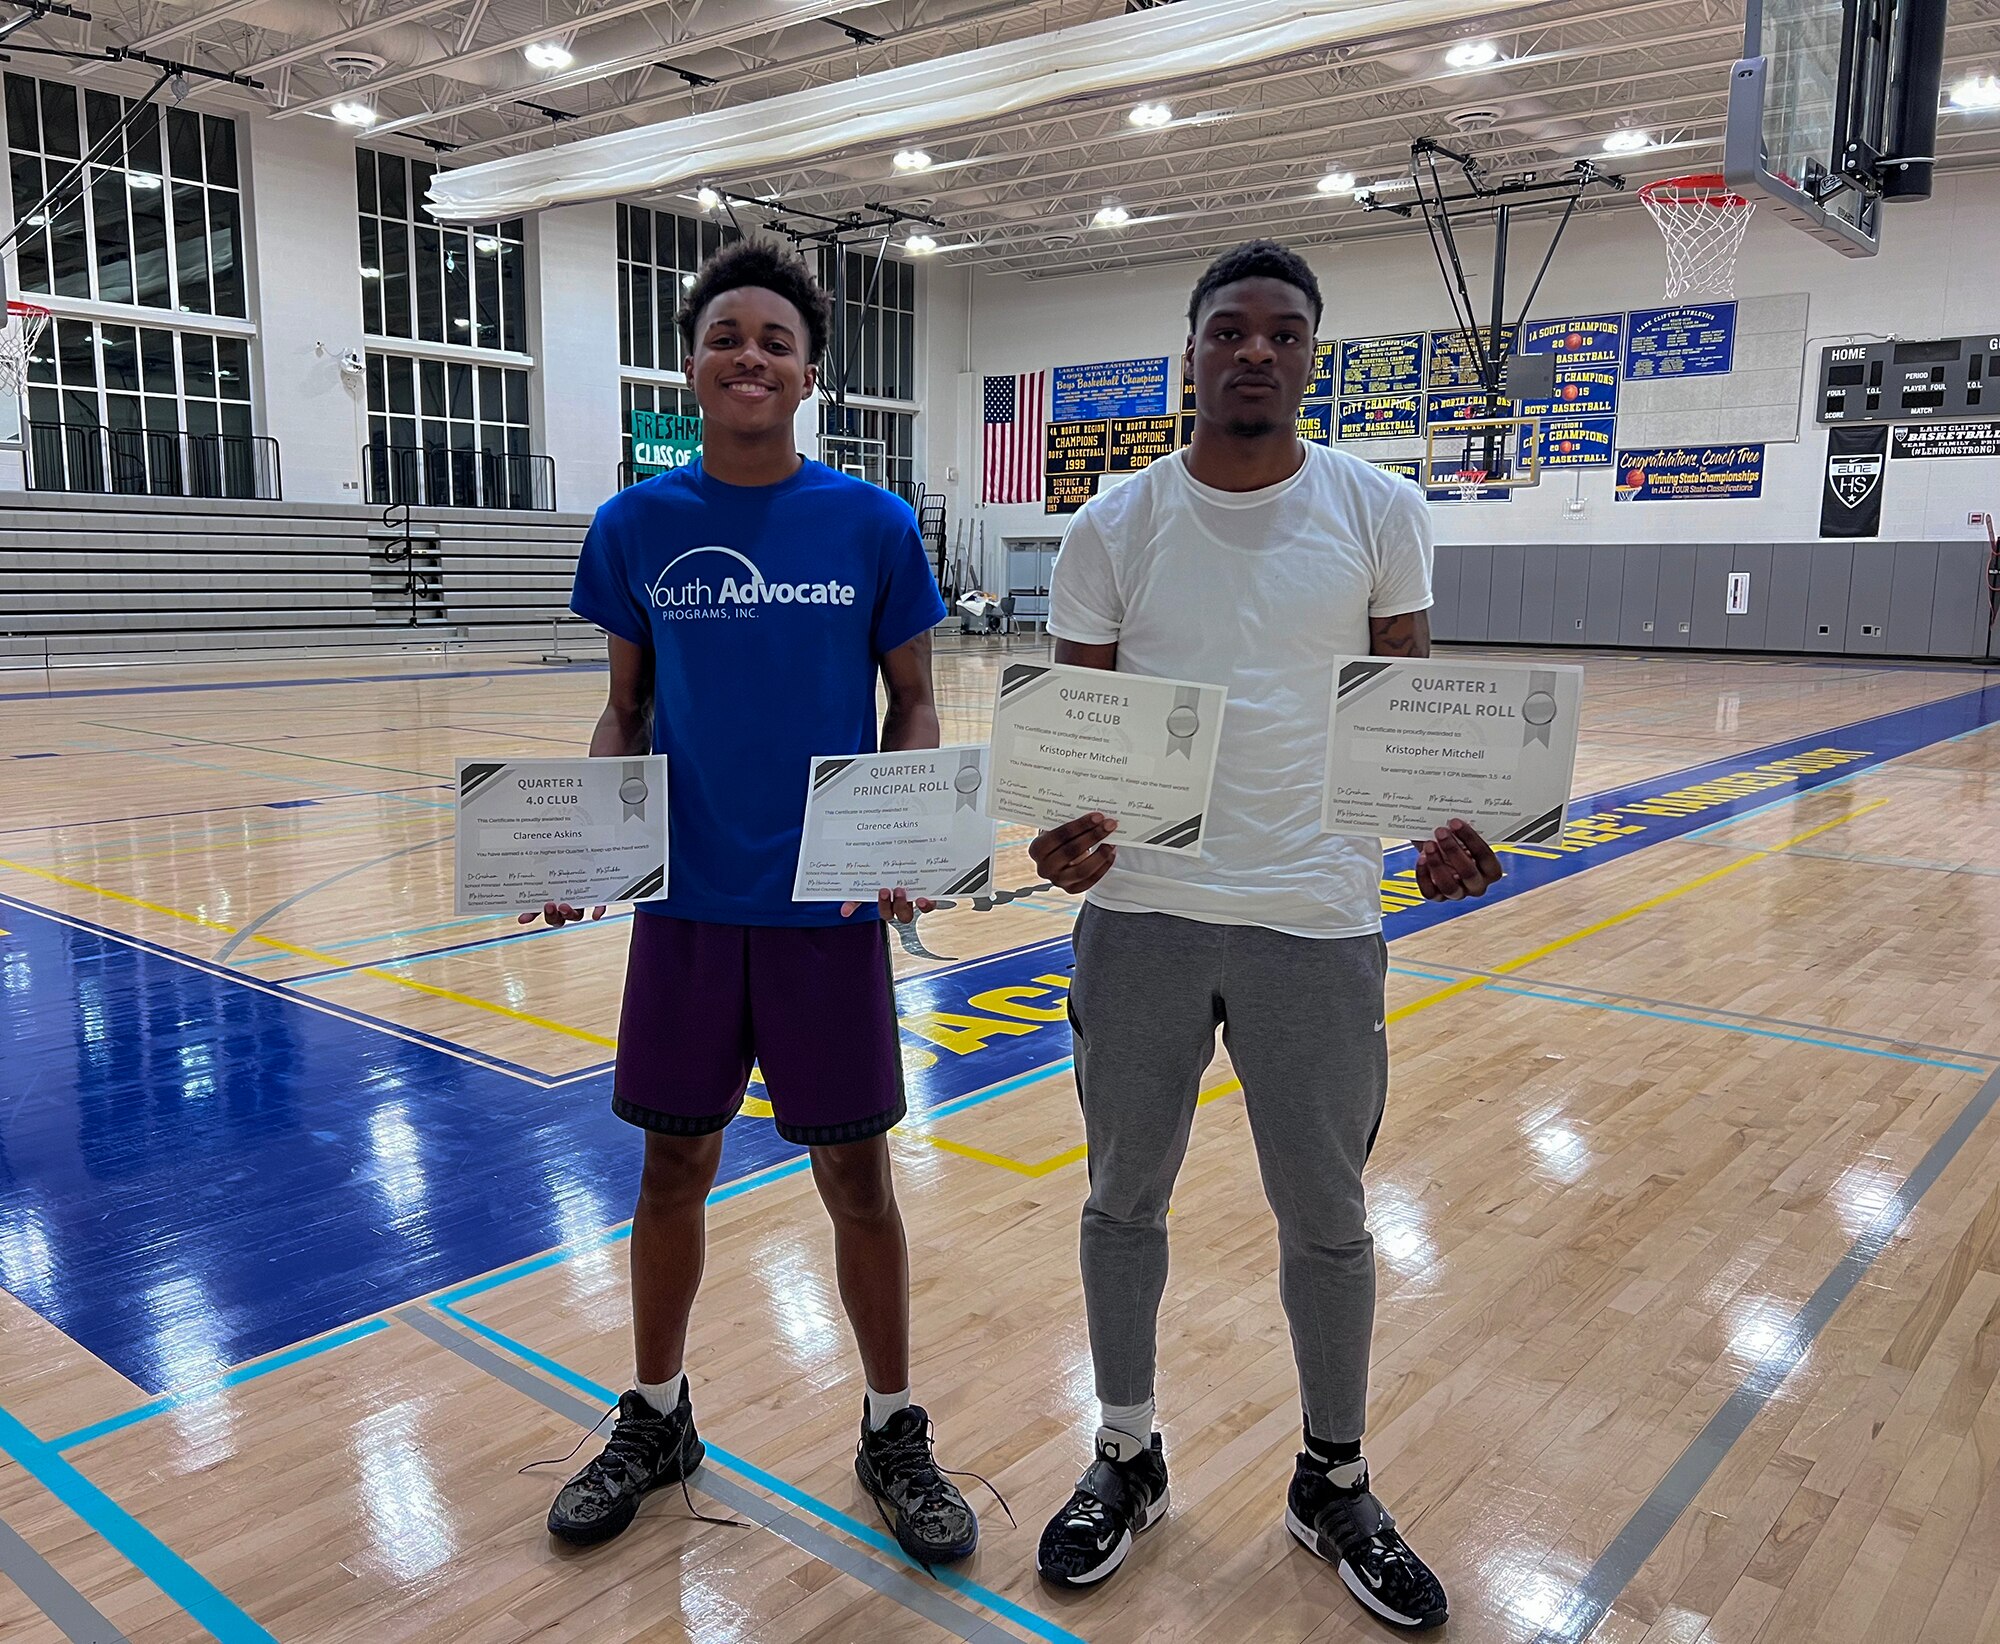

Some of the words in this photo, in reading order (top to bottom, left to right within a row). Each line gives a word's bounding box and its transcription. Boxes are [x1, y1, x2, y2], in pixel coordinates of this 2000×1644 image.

[1636, 321, 1652, 332] LAKE
[1654, 311, 1679, 322] CLIFTON
[1682, 310, 1715, 320] ATHLETICS
[1529, 331, 1537, 342] 1A
[1539, 323, 1566, 337] SOUTH
[1569, 322, 1618, 334] CHAMPIONS
[1552, 340, 1564, 348] 20
[1583, 337, 1592, 346] 16
[1556, 351, 1615, 363] BASKETBALL
[1832, 348, 1866, 361] HOME
[1056, 381, 1075, 390] Boys
[1077, 375, 1119, 388] Basketball
[1122, 374, 1164, 385] Champions
[1565, 373, 1614, 386] CHAMPIONS
[1905, 372, 1928, 380] PERIOD
[1579, 387, 1589, 396] 15
[1343, 401, 1362, 416] CITY
[1365, 398, 1416, 411] CHAMPIONS
[1441, 397, 1465, 408] NORTH
[1525, 405, 1549, 415] BOYS'
[1552, 401, 1611, 413] BASKETBALL
[635, 411, 703, 441] FRESHM
[1050, 427, 1057, 436] 4A
[1061, 425, 1082, 435] NORTH
[1084, 424, 1105, 433] REGION
[1115, 422, 1122, 431] 4A
[1126, 421, 1146, 431] NORTH
[1151, 419, 1173, 429] REGION
[1342, 422, 1365, 433] BOYS'
[1366, 420, 1415, 431] BASKETBALL
[1056, 435, 1098, 448] CHAMPIONS
[1120, 432, 1165, 444] CHAMPIONS
[1549, 429, 1608, 444] CHAMPIONS
[1907, 430, 2000, 441] BASKETBALL
[635, 442, 673, 467] CLASS
[675, 448, 692, 466] OF
[1068, 448, 1104, 458] BASKETBALL
[1133, 444, 1172, 454] BASKETBALL
[1911, 445, 1995, 456] (#LENNONSTRONG)
[1065, 459, 1085, 470] 1999
[1131, 456, 1151, 467] 2001
[1550, 452, 1607, 464] BASKETBALL
[1620, 449, 1699, 472] Congratulations,
[1702, 449, 1734, 466] Coach
[1738, 448, 1760, 464] Tree
[1053, 478, 1082, 486] DISTRICT
[1648, 473, 1678, 486] Winning
[1679, 472, 1698, 482] State
[1700, 470, 1759, 485] Championships
[1054, 486, 1089, 495] CHAMPS
[1658, 486, 1671, 494] ALL
[1672, 485, 1689, 493] FOUR
[1690, 485, 1706, 493] State
[1706, 483, 1753, 493] Classifications
[1840, 477, 1867, 493] HS
[644, 577, 712, 608] Youth
[718, 576, 856, 606] Advocate
[662, 608, 731, 621] PROGRAMS,
[735, 608, 759, 619] INC.
[1411, 677, 1485, 694] QUARTER
[1489, 682, 1497, 694] 1
[1059, 688, 1118, 706] QUARTER
[1123, 697, 1129, 707] 1
[1389, 699, 1471, 715] PRINCIPAL
[1475, 704, 1516, 718] ROLL
[1065, 708, 1084, 721] 4.0
[1087, 711, 1121, 726] CLUB
[1025, 726, 1051, 734] Certificate
[1057, 731, 1078, 739] proudly
[1079, 734, 1102, 742] awarded
[1402, 728, 1426, 736] proudly
[1039, 744, 1087, 760] Kristopher
[1089, 749, 1128, 765] Mitchell
[1385, 744, 1439, 757] Kristopher
[1441, 748, 1485, 760] Mitchell
[870, 765, 926, 779] QUARTER
[929, 764, 935, 774] 1
[518, 779, 574, 790] QUARTER
[577, 778, 583, 788] 1
[853, 784, 915, 796] PRINCIPAL
[919, 781, 949, 793] ROLL
[1612, 771, 1799, 817] HARRIED
[1754, 747, 1875, 775] COURT
[526, 796, 544, 806] 4.0
[547, 795, 578, 805] CLUB
[856, 821, 891, 831] Clarence
[893, 820, 919, 829] Askins
[513, 831, 551, 840] Clarence
[554, 829, 582, 839] Askins
